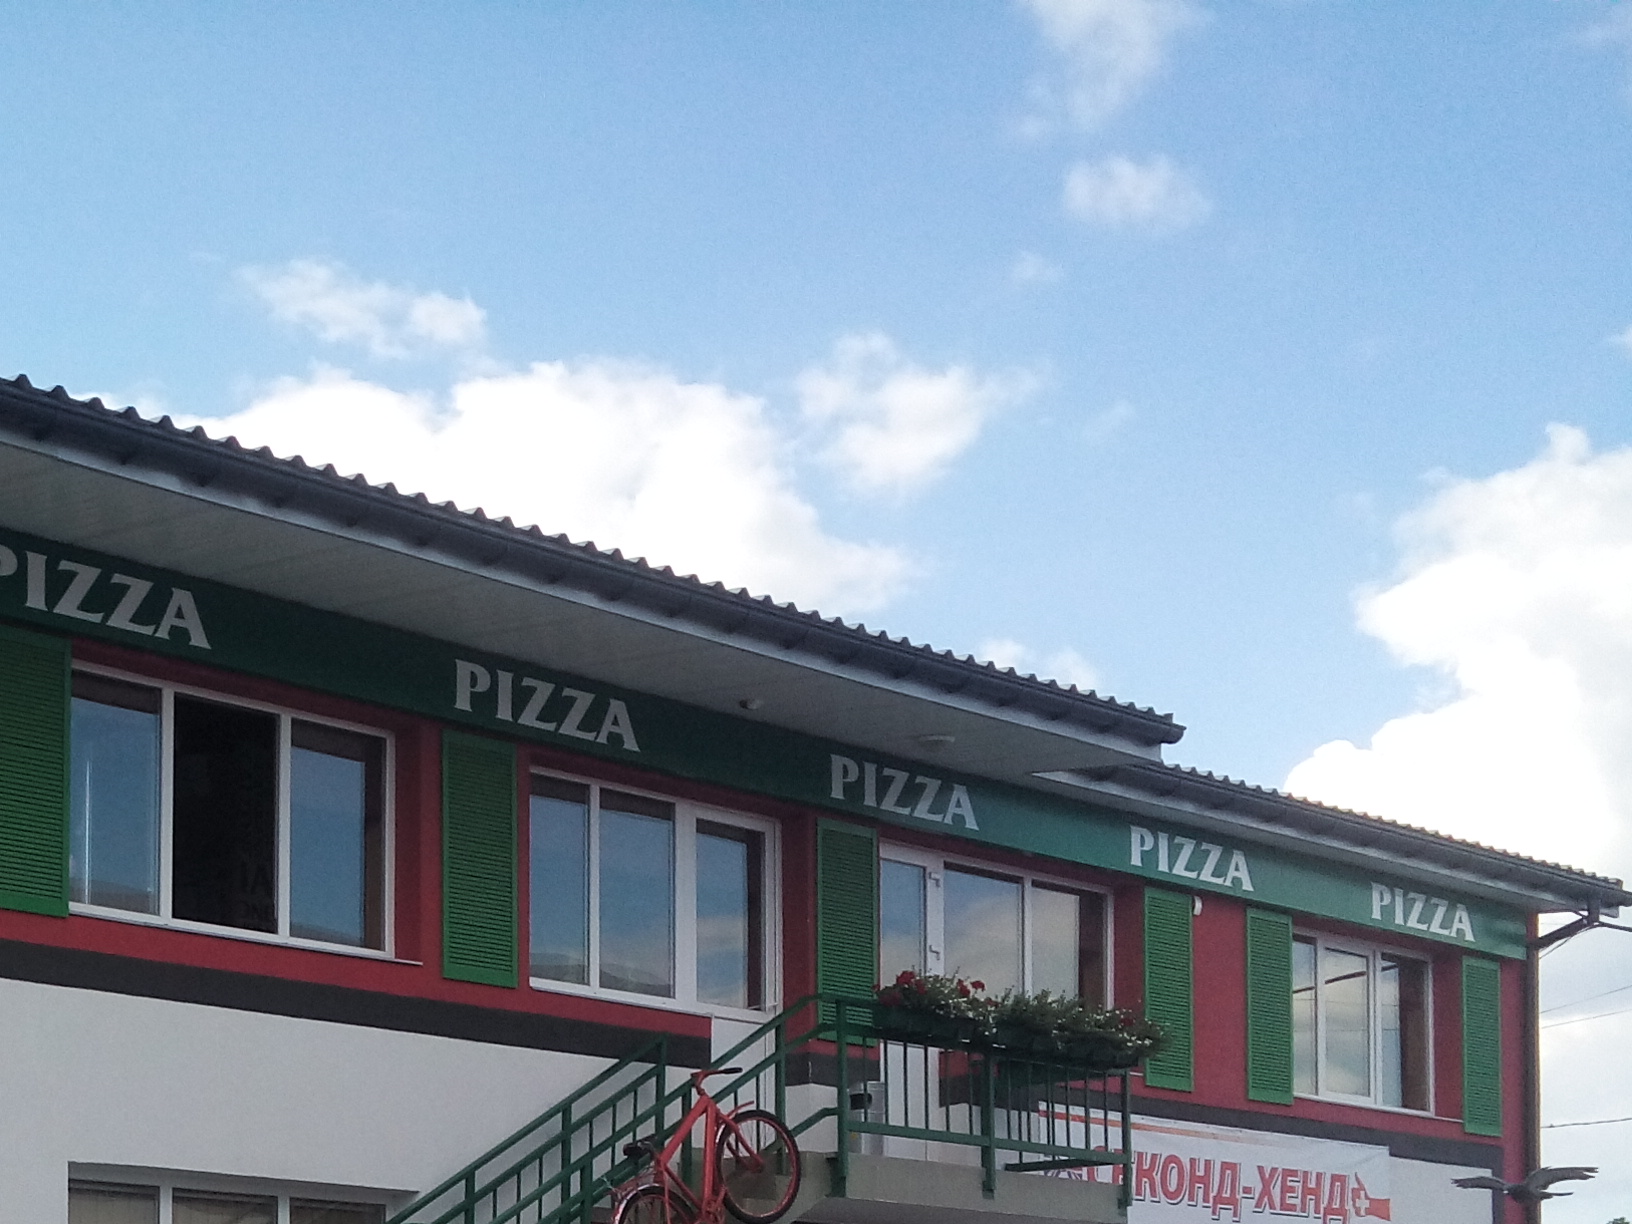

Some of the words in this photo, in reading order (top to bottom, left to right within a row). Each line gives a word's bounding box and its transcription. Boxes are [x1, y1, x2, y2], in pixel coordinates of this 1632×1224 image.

[454, 658, 641, 752] PIZZA
[829, 754, 979, 831] PIZZA
[1129, 824, 1254, 892] PIZZA
[1371, 881, 1476, 942] PIZZA
